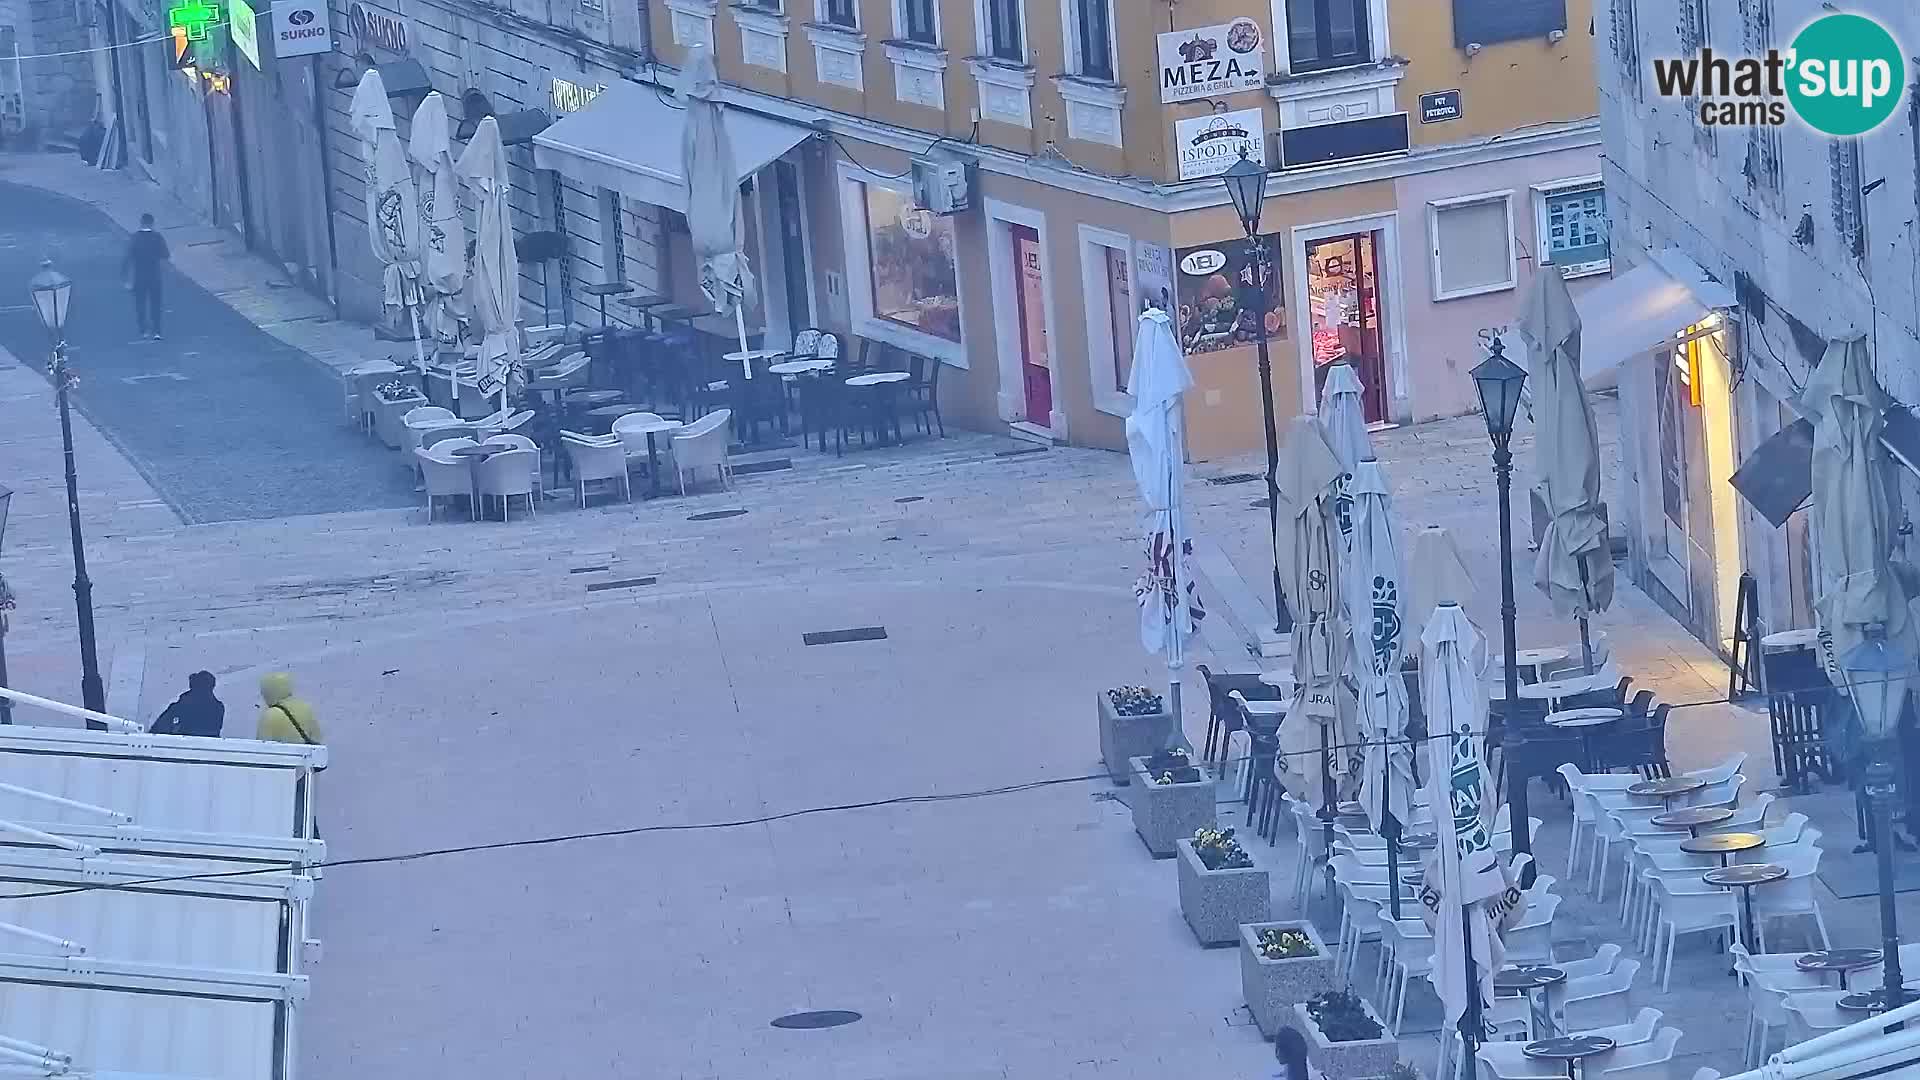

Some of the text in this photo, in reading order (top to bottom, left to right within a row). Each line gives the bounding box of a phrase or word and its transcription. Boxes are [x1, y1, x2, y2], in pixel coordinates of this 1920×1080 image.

[280, 27, 325, 41] SUKNO
[366, 11, 407, 50] SUKNO
[1164, 58, 1242, 88] MEZA
[1173, 84, 1206, 96] PIZZERIA
[1213, 80, 1235, 90] GRILL
[1434, 97, 1446, 106] PUT
[1182, 143, 1228, 161] ISPOD
